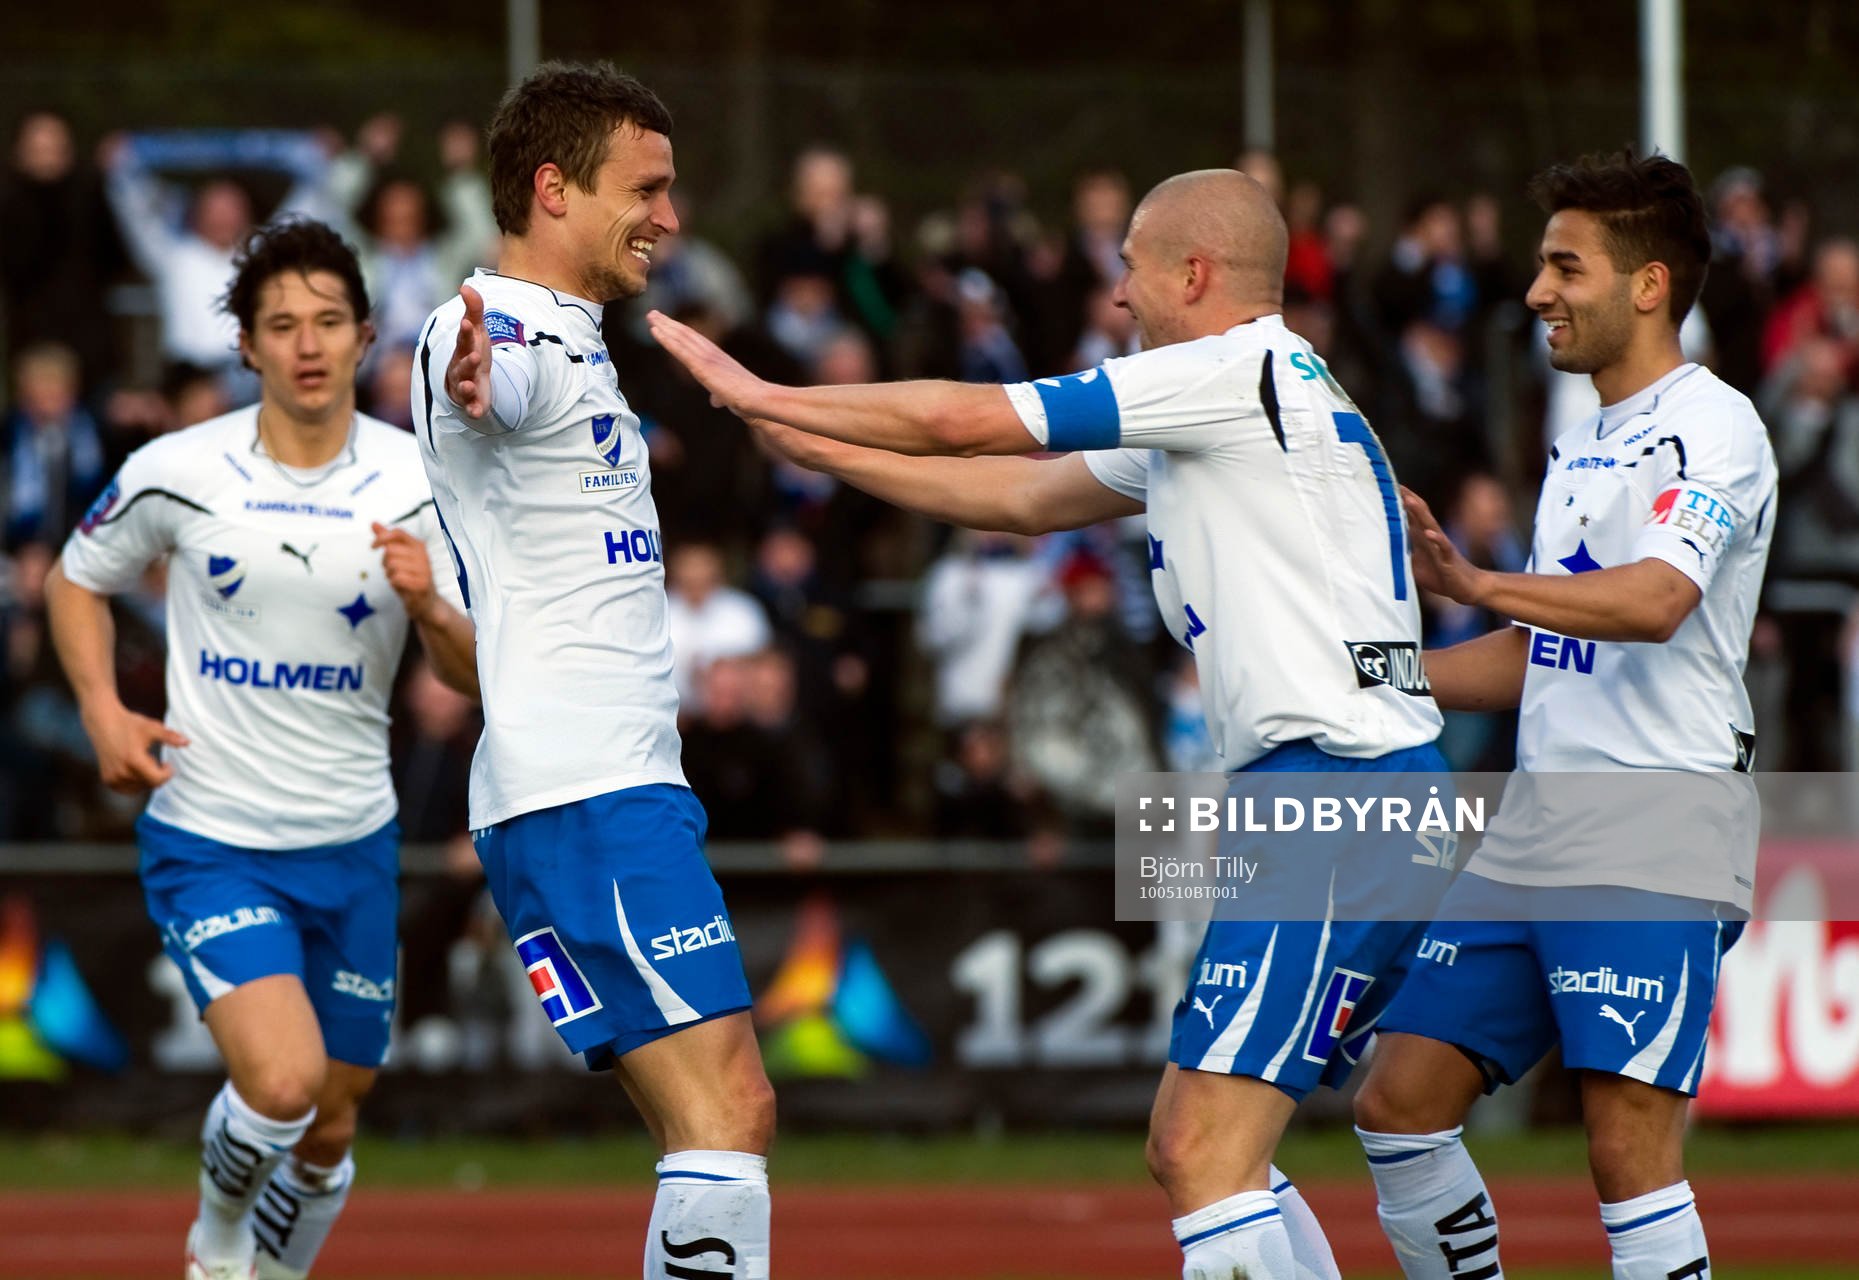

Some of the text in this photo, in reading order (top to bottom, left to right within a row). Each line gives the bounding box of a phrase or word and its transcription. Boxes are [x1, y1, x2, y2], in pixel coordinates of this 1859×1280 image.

[584, 472, 638, 488] FAMILJEN
[200, 649, 364, 692] HOLMEN
[1549, 966, 1664, 1003] stadium
